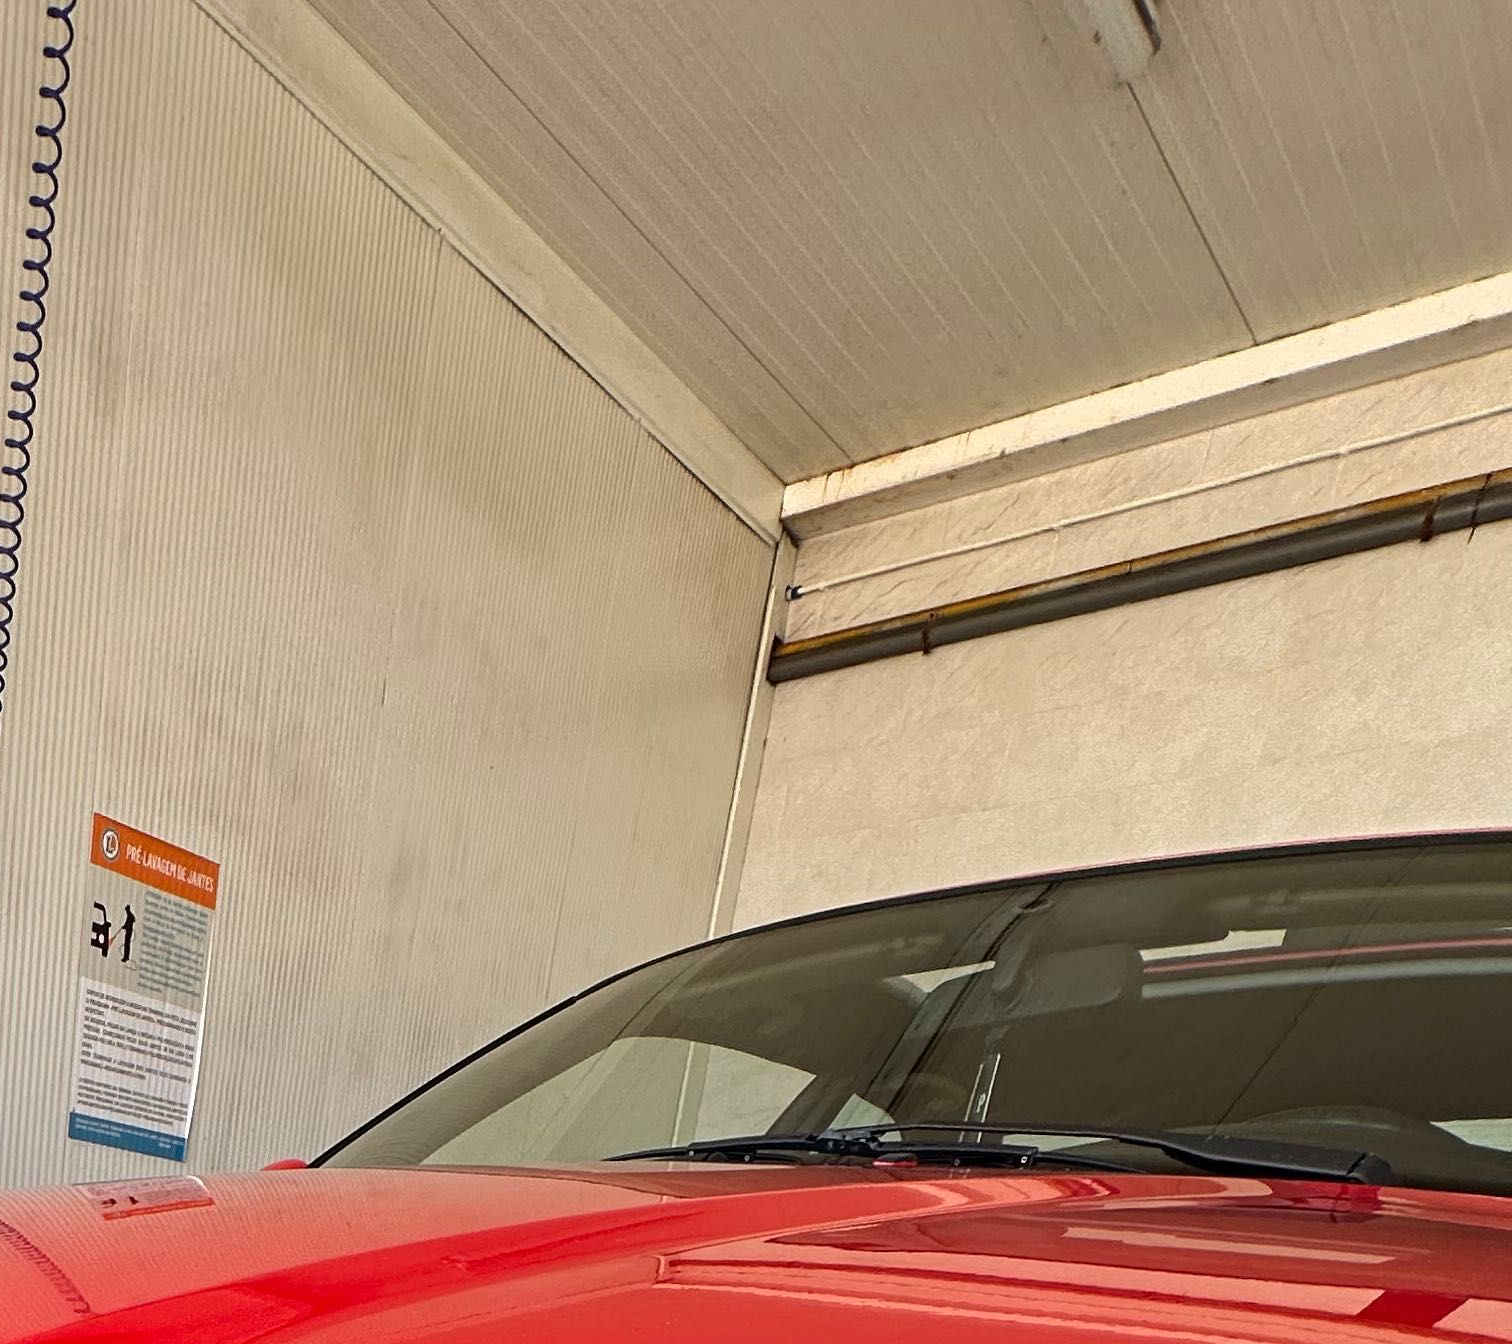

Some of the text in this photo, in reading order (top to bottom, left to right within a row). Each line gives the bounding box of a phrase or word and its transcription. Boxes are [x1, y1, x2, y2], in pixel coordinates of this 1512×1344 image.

[126, 843, 215, 893] PRÉ-LAVAGEM DE JANTES
